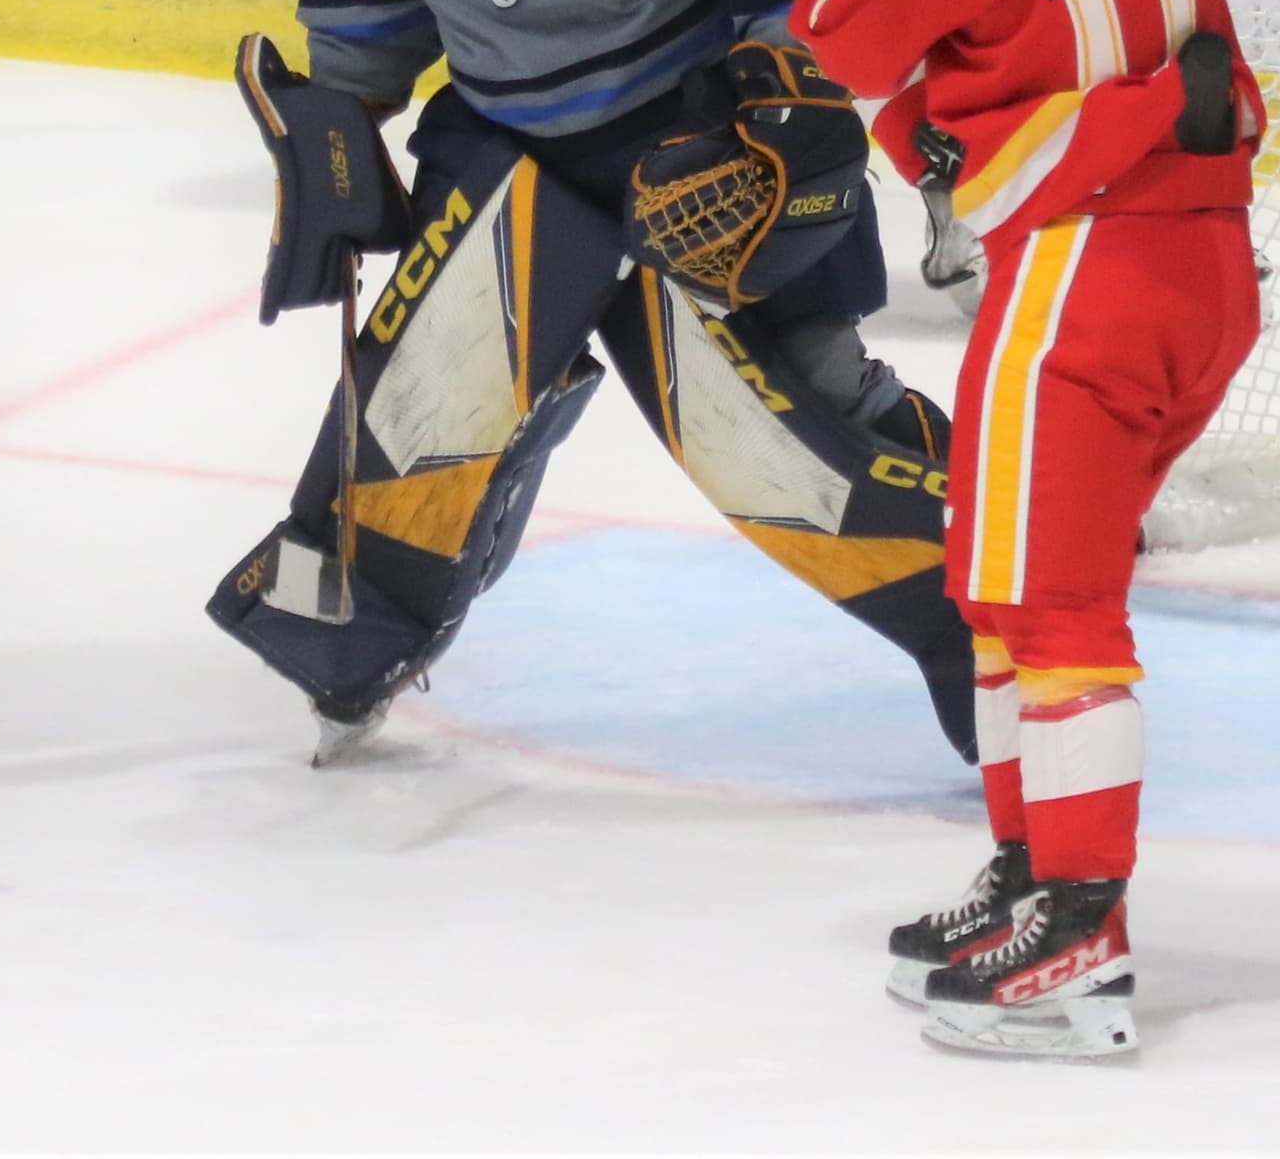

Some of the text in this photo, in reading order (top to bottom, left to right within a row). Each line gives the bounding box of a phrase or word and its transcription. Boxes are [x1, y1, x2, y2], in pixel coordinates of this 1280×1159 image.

[371, 187, 472, 344] CCM
[685, 296, 795, 414] CM
[943, 912, 991, 943] CCM
[999, 937, 1110, 1005] CCM
